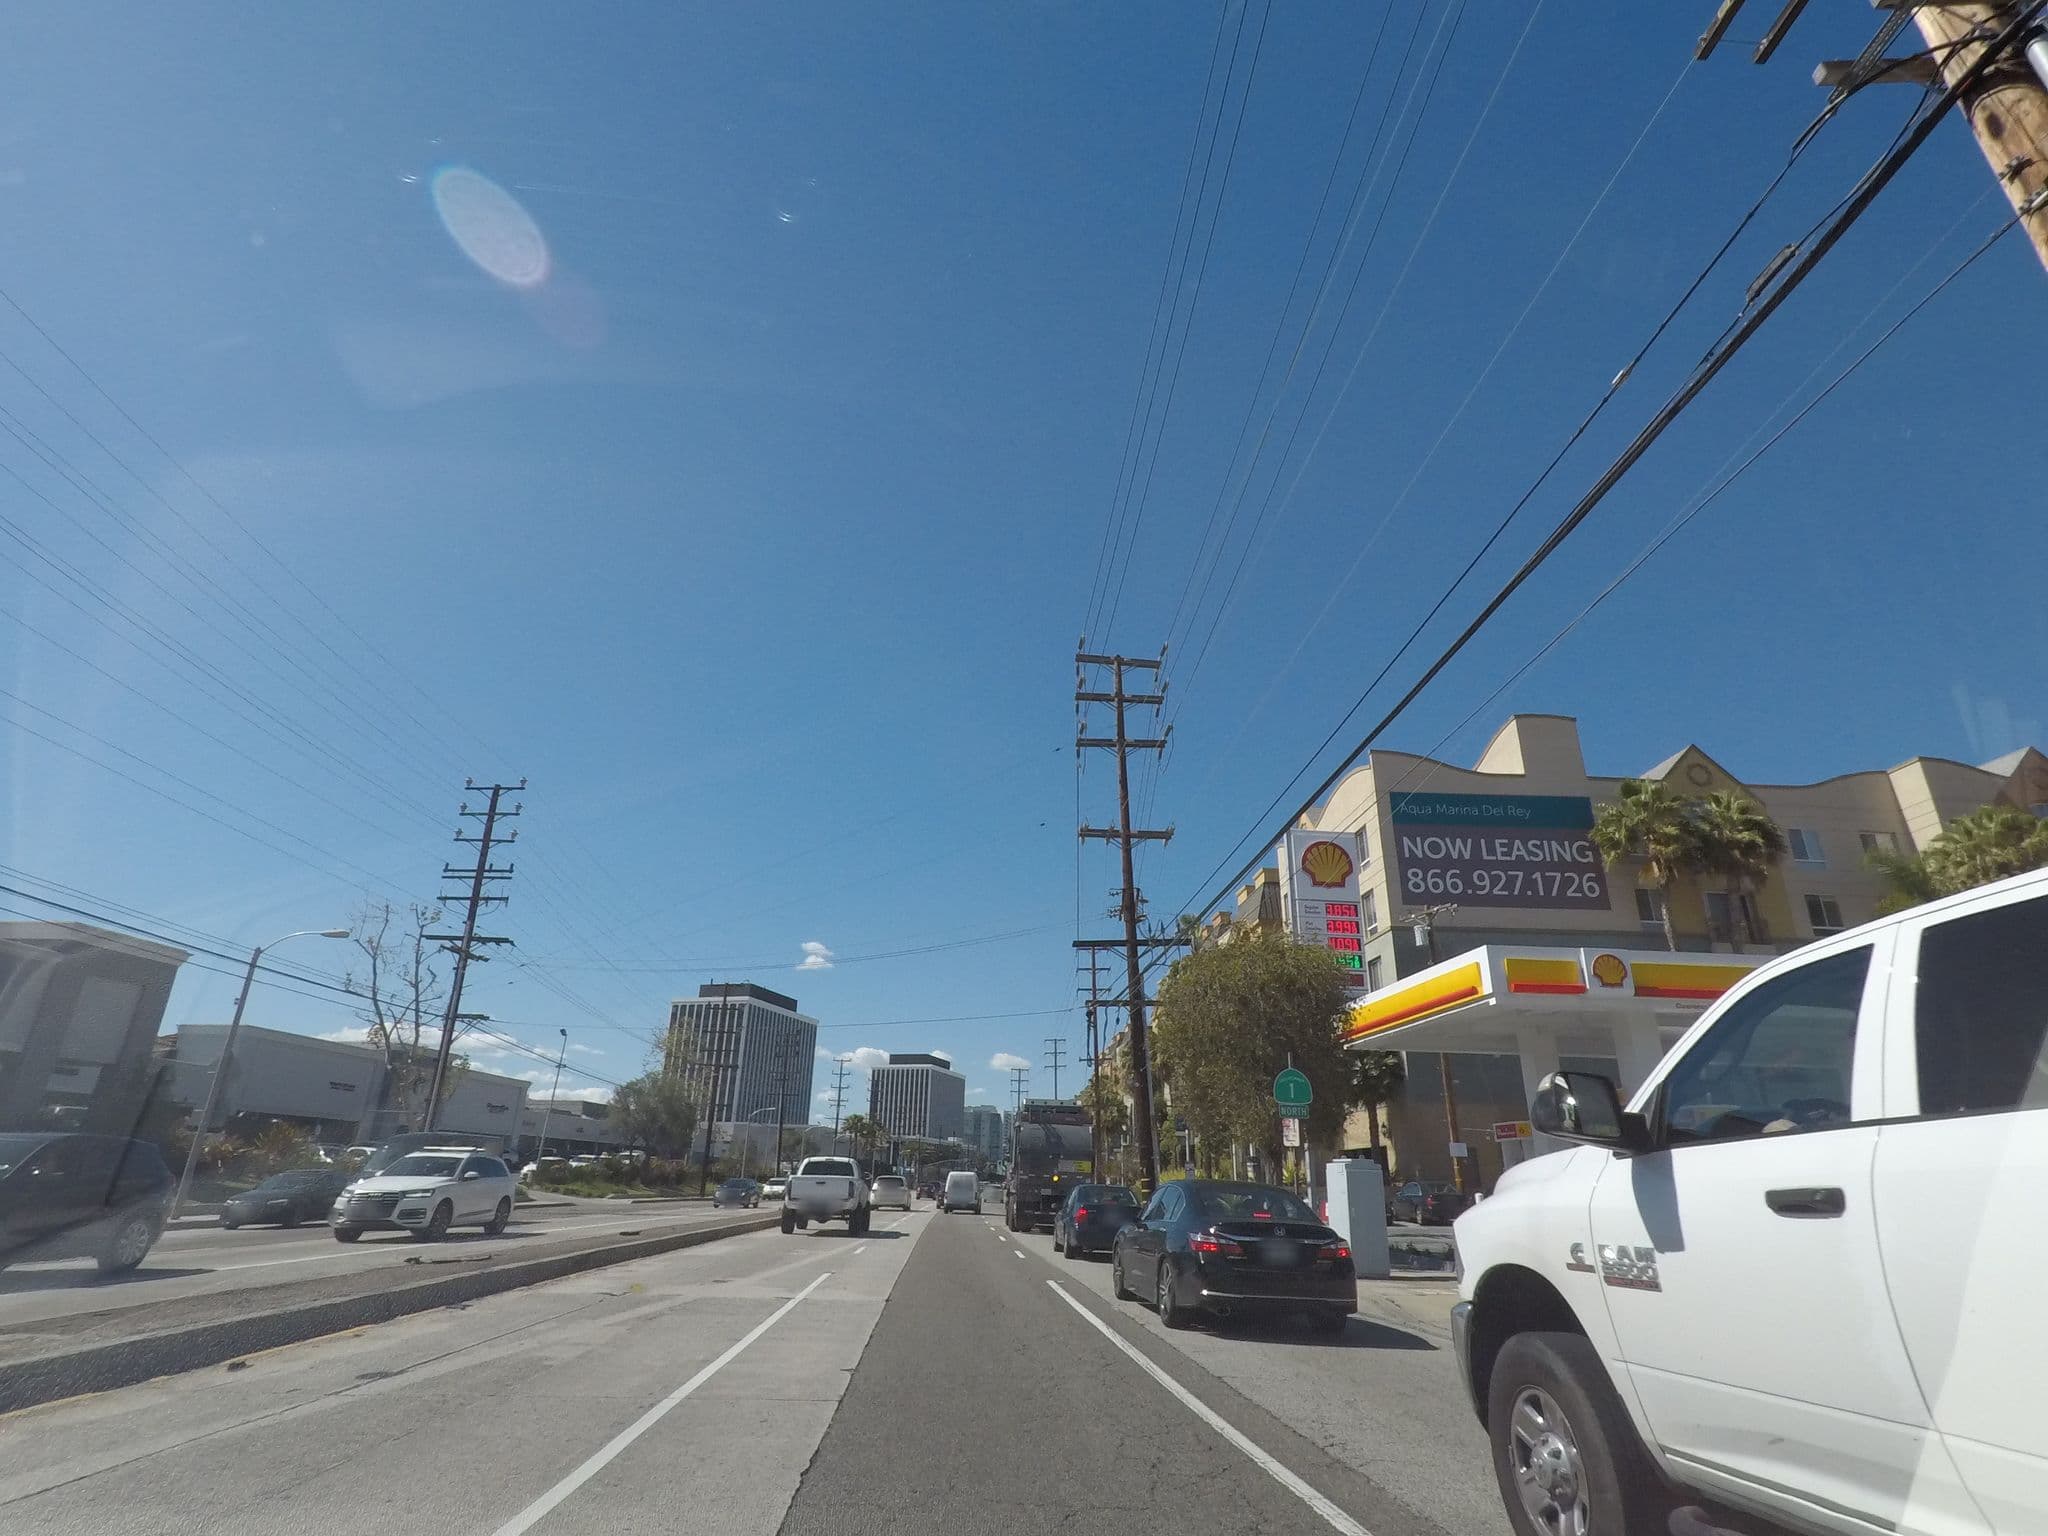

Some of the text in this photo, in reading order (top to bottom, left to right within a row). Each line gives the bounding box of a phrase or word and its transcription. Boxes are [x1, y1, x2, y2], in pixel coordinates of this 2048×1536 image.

[1400, 804, 1532, 820] Aqua Marina Del Rey
[1402, 836, 1594, 864] NOW LEASING
[1407, 868, 1601, 898] 866.927.1726
[1289, 1083, 1294, 1099] 1
[1281, 1107, 1307, 1116] NORTH
[1598, 1244, 1657, 1263] RAM
